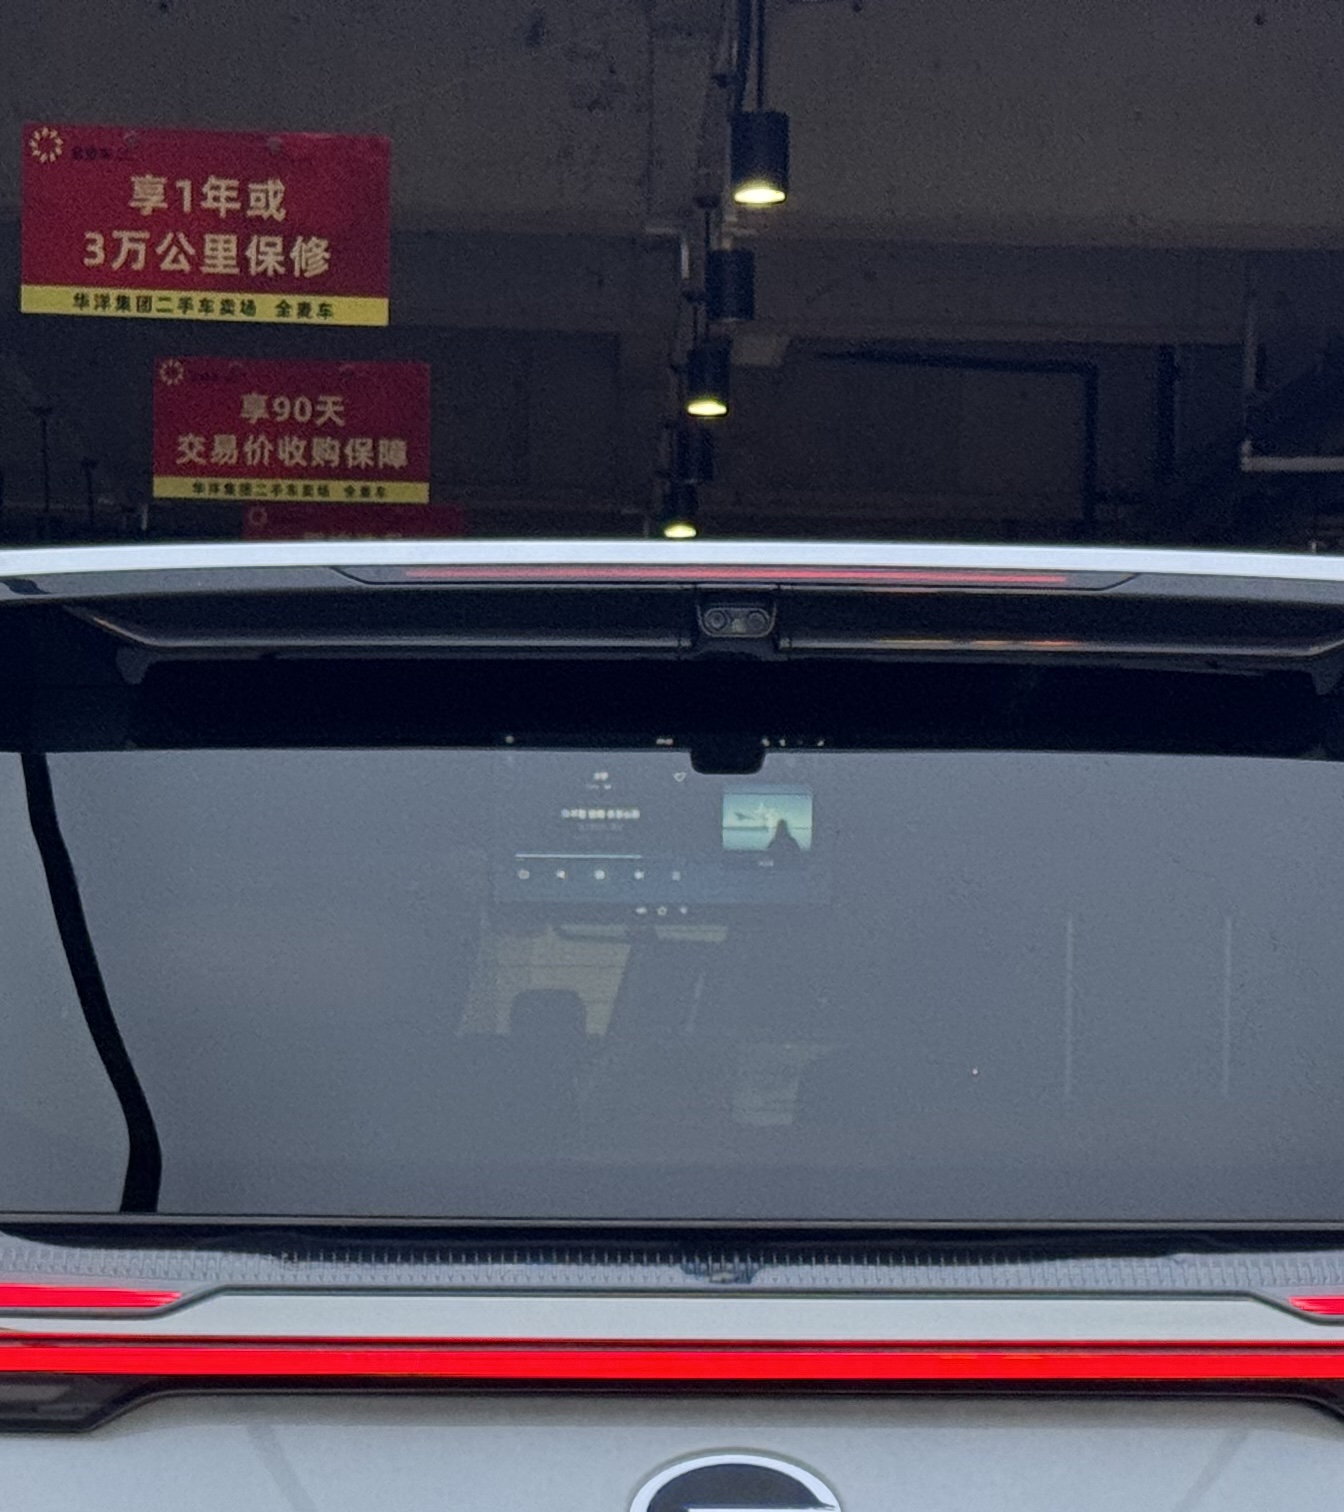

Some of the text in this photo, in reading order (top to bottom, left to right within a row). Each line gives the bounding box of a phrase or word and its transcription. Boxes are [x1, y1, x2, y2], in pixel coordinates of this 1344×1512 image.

[129, 174, 287, 221] 享1年或
[84, 230, 332, 279] 3万公里保修
[274, 299, 335, 320] 全麦车
[240, 392, 346, 428] 享90天
[176, 433, 408, 470] 交易价收购保障
